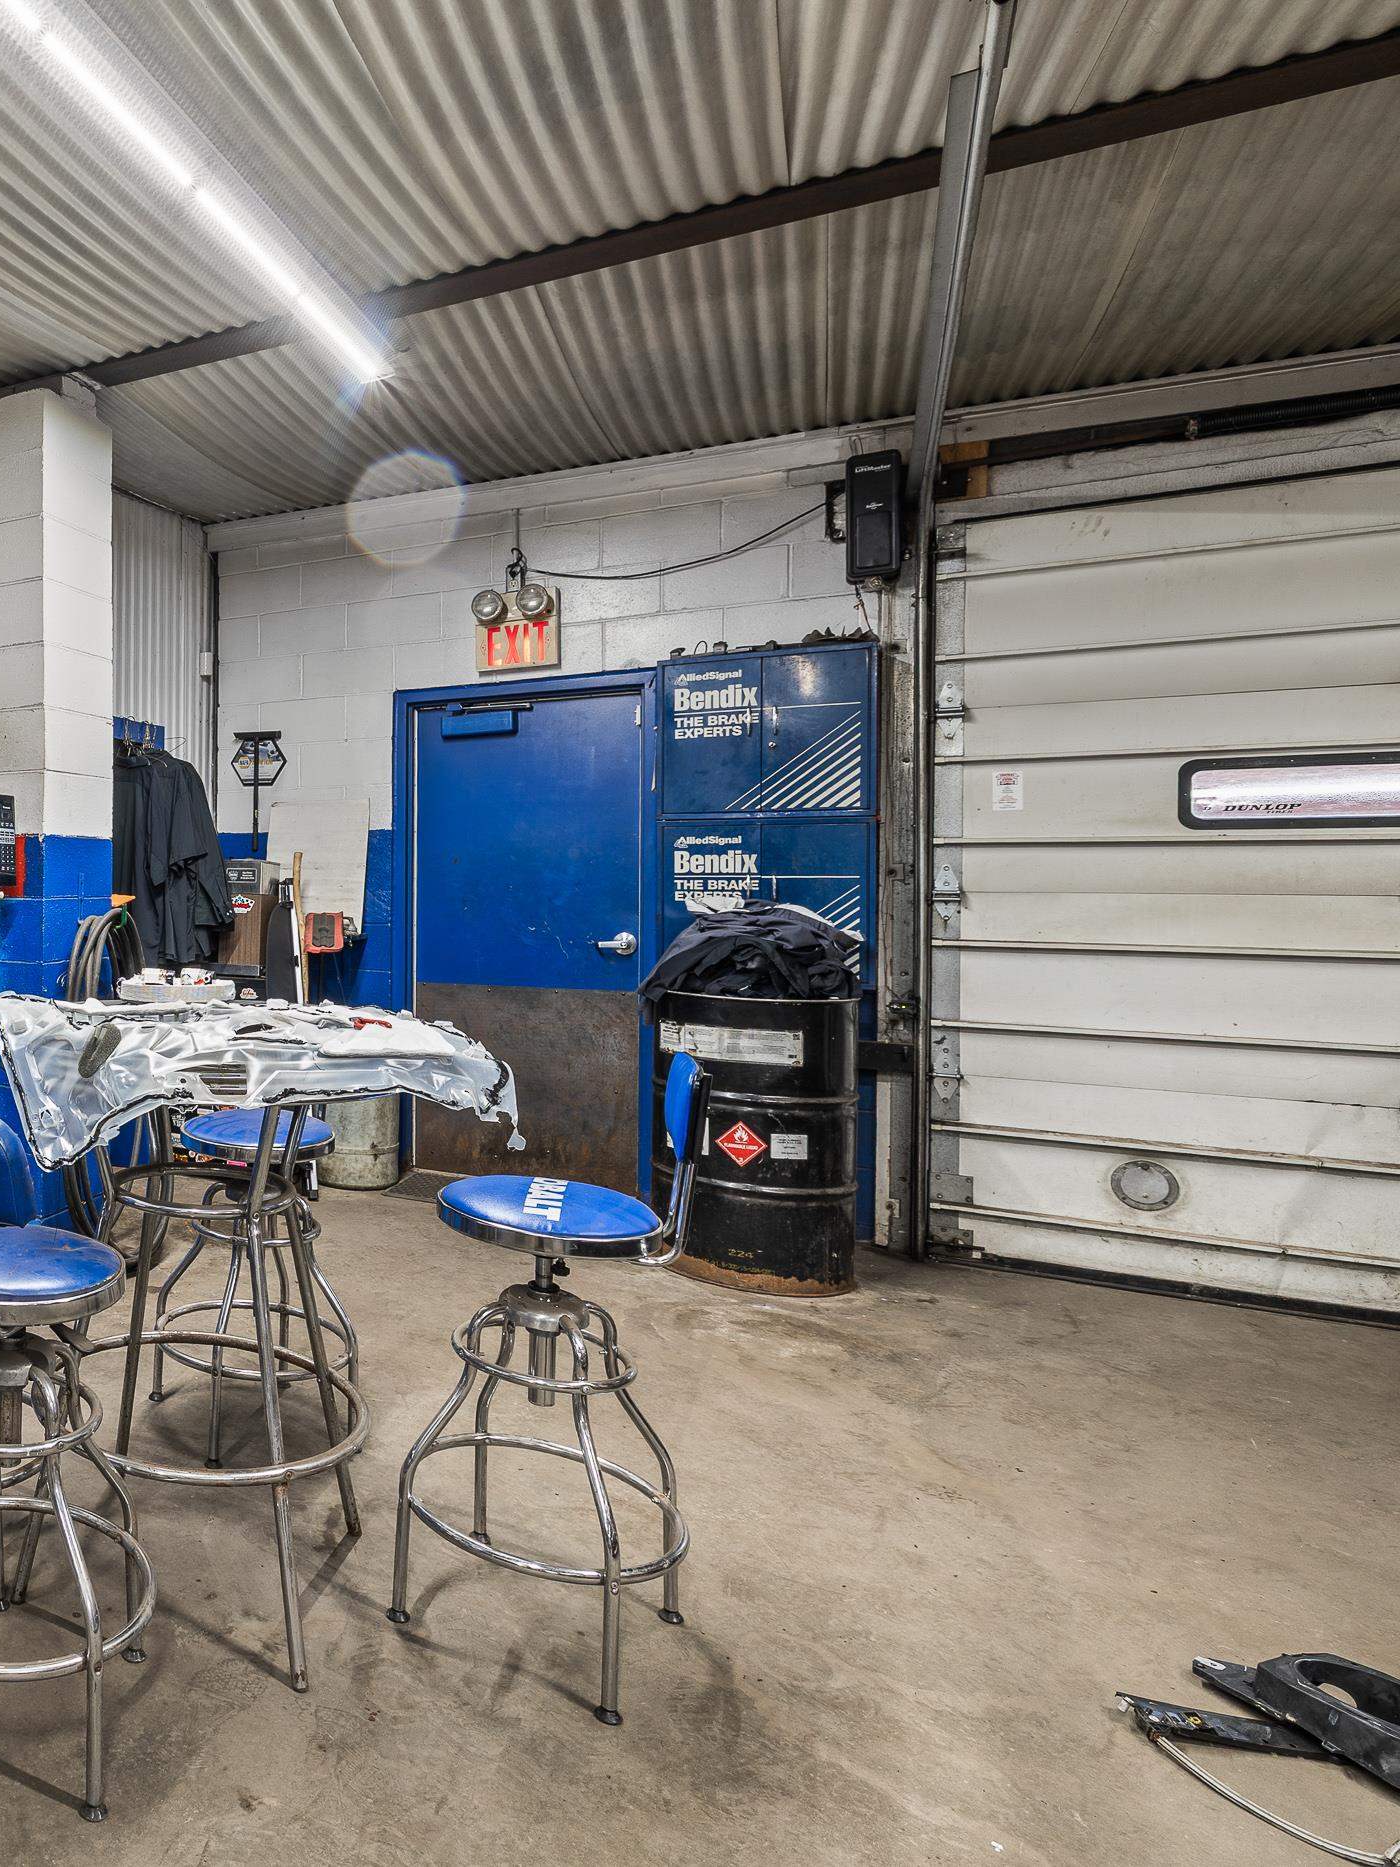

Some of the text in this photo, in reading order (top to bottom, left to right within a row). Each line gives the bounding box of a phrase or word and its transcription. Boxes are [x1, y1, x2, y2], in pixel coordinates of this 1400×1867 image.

[487, 620, 549, 667] EXIT
[676, 669, 742, 685] AlliedSignal
[674, 684, 758, 711] Bendix
[674, 712, 760, 728] THE BRAKE
[674, 725, 743, 740] EXPERTS
[1223, 803, 1302, 812] DUNLOP
[676, 836, 742, 849] AlliedSignal
[674, 850, 758, 875] Bendix
[674, 879, 760, 890] THE BRAKE
